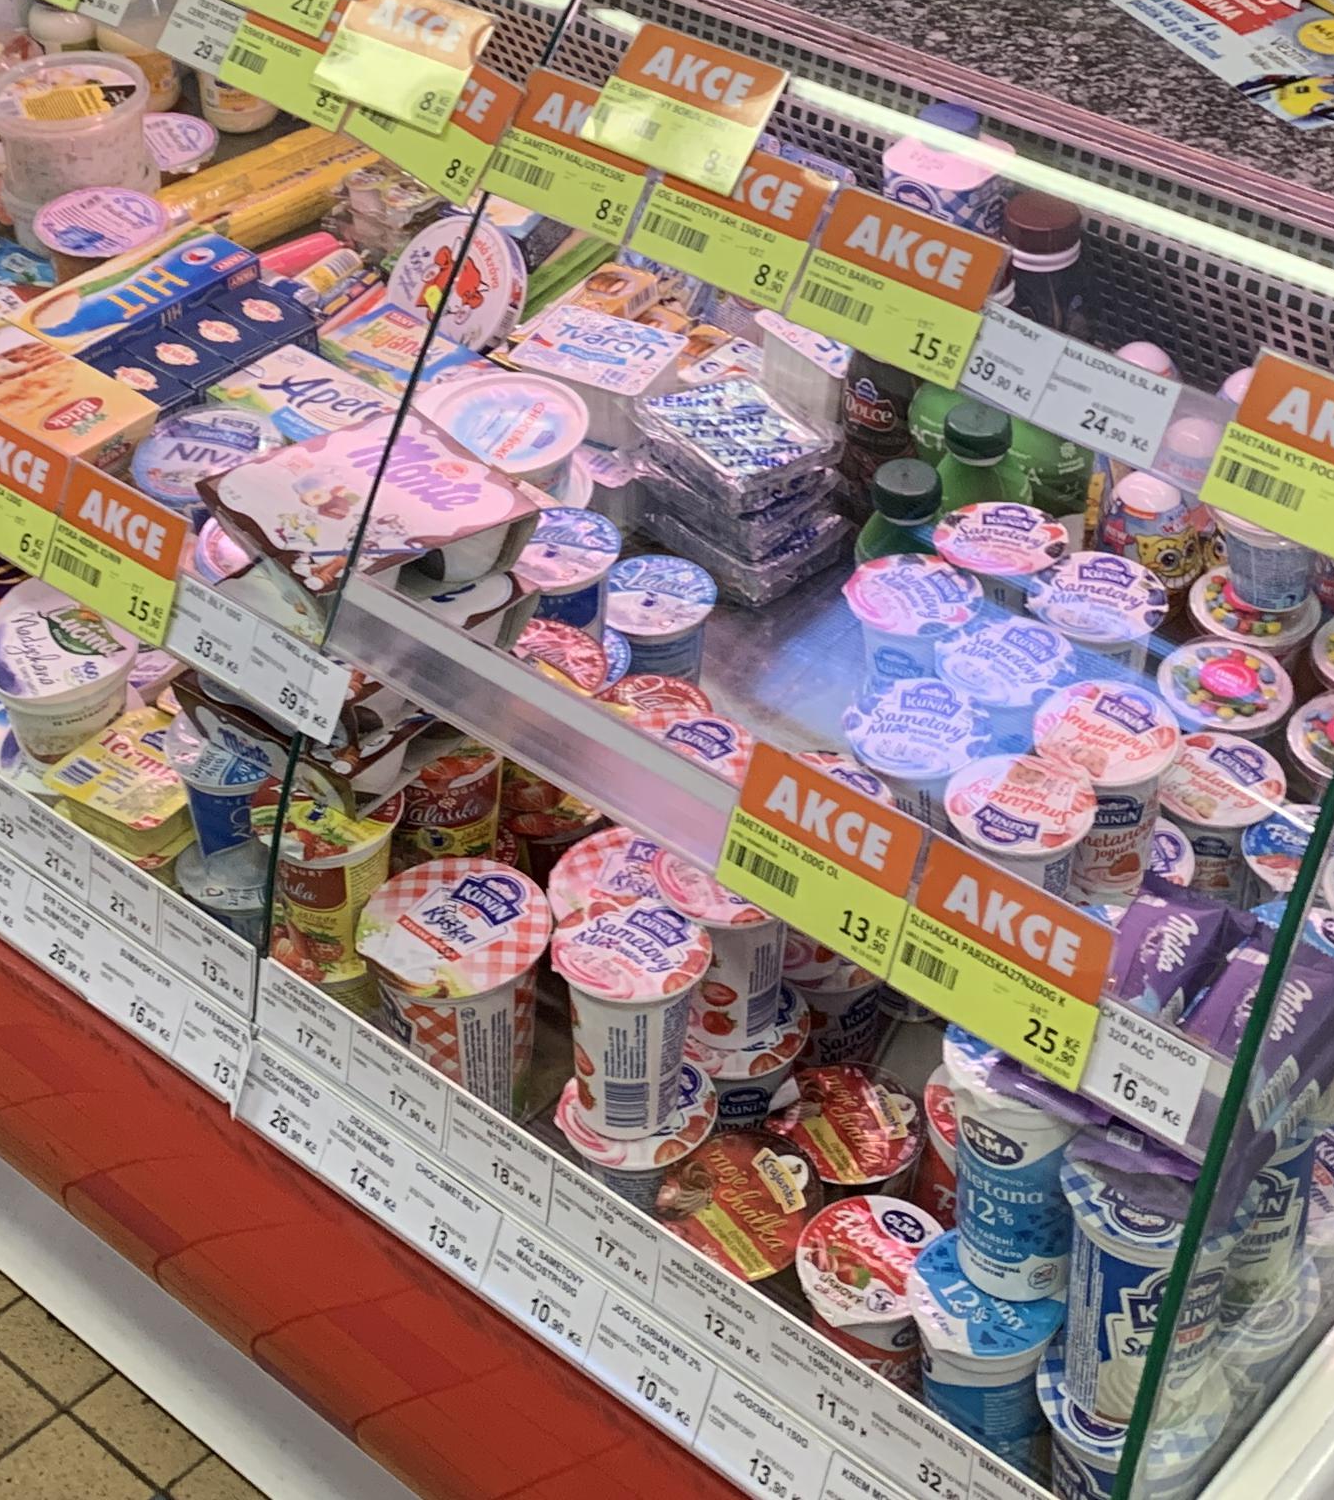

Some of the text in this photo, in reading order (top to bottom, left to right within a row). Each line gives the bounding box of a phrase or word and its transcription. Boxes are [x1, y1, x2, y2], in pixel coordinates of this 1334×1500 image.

[641, 45, 755, 108] AKCE
[674, 194, 719, 221] SAMETOVY
[844, 215, 973, 291] AKCE
[555, 322, 658, 362] Tvaroh
[1009, 319, 1041, 343] SPRAY
[1085, 353, 1127, 382] LEDOVA
[1228, 428, 1282, 458] SMETANA
[1284, 451, 1308, 470] KYS.
[78, 490, 167, 562] AKCE
[735, 812, 779, 843] SMETANA
[801, 851, 824, 872] 200G
[764, 775, 893, 872] AKCE
[909, 913, 959, 949] SLEHACKA
[943, 874, 1081, 977] AKCE
[1155, 913, 1199, 973] Milka
[1106, 1027, 1154, 1061] 32G ACC
[1117, 1010, 1153, 1043] MILKA
[1155, 1033, 1197, 1066] CHOCO
[1162, 1108, 1182, 1127] Kč
[734, 1391, 785, 1437] JOGOBELA
